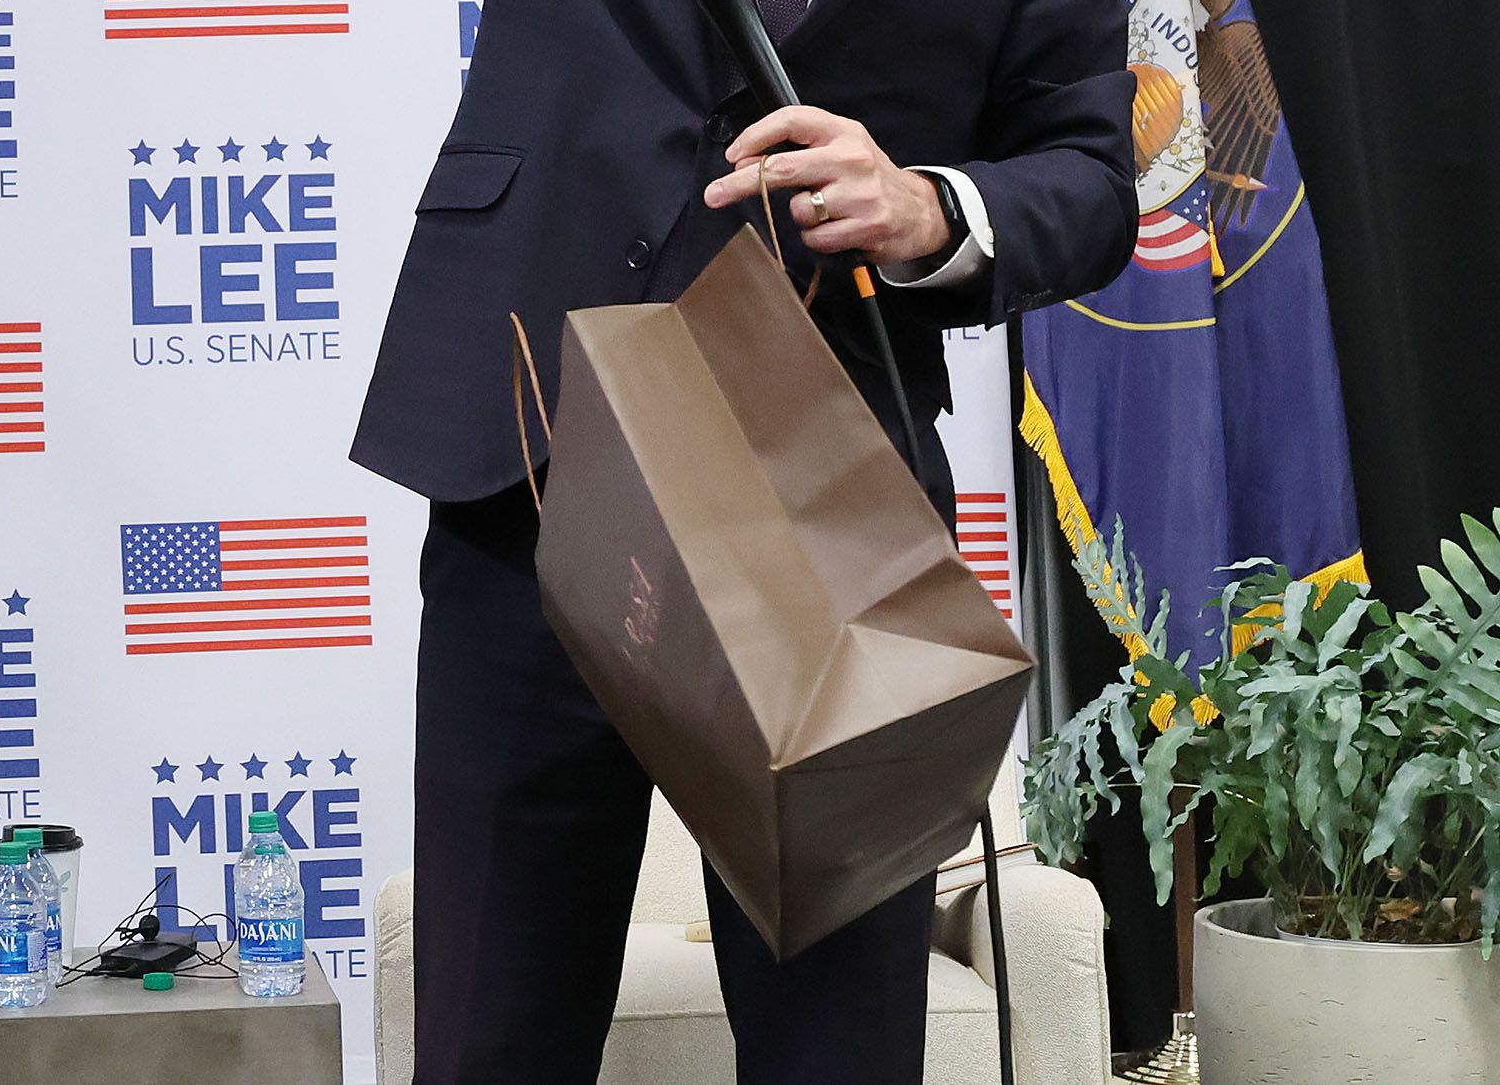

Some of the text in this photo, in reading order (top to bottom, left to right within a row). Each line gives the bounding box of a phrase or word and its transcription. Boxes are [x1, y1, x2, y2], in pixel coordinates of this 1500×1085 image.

[128, 173, 337, 236] MIKE
[130, 241, 340, 326] LEE
[132, 331, 341, 366] U.S. SENATE
[151, 788, 363, 856] MIKE
[240, 921, 298, 945] DASANI
